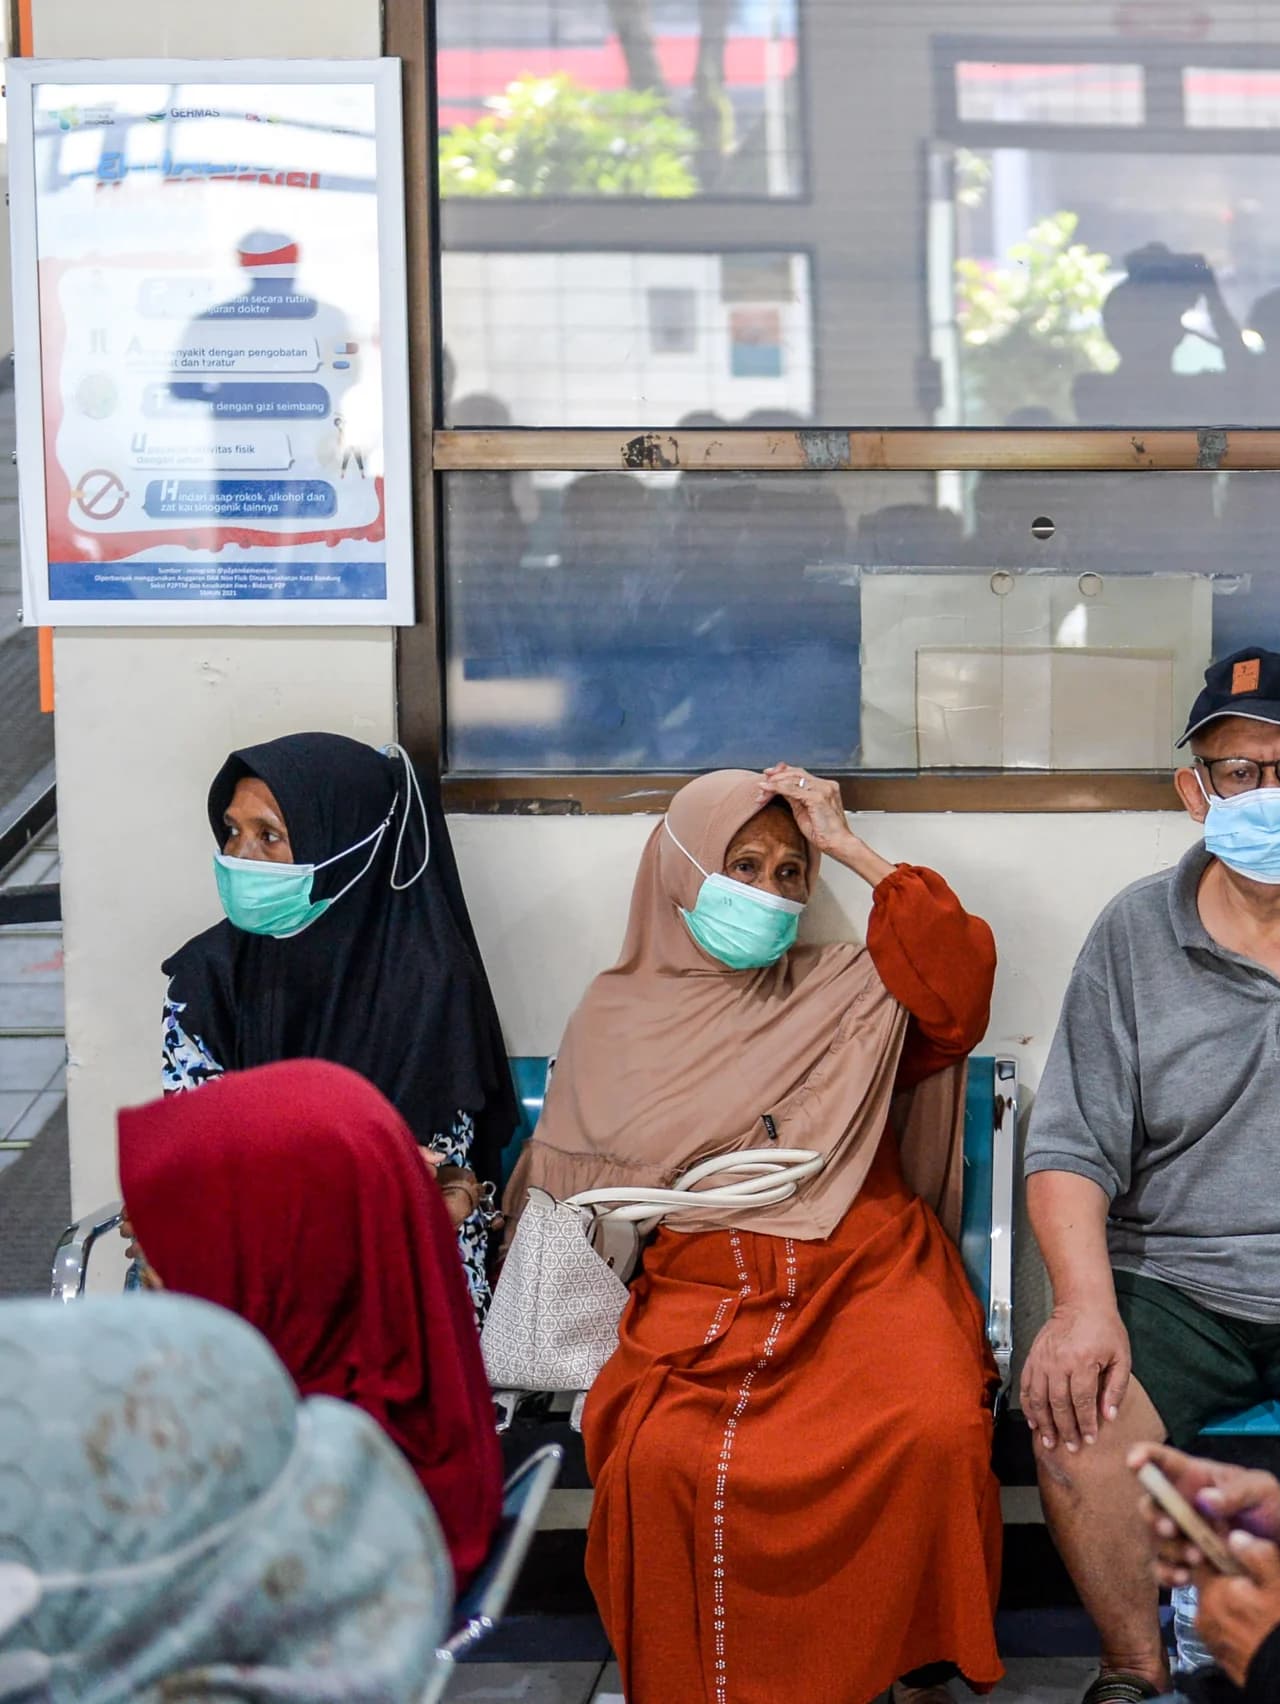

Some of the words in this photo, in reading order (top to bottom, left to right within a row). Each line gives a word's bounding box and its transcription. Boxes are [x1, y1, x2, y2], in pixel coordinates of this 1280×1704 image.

[251, 296, 283, 304] secara
[286, 295, 309, 304] rutin
[238, 304, 270, 314] dokter
[208, 348, 246, 359] dengan
[248, 348, 308, 359] pengobatan
[181, 359, 199, 368] dan
[216, 402, 252, 412] dengan
[256, 402, 274, 412] gizi
[276, 402, 324, 412] seimbang
[234, 444, 256, 455] fisik
[234, 492, 266, 503] rokok,
[306, 492, 326, 502] dan
[243, 502, 279, 513] lainnya
